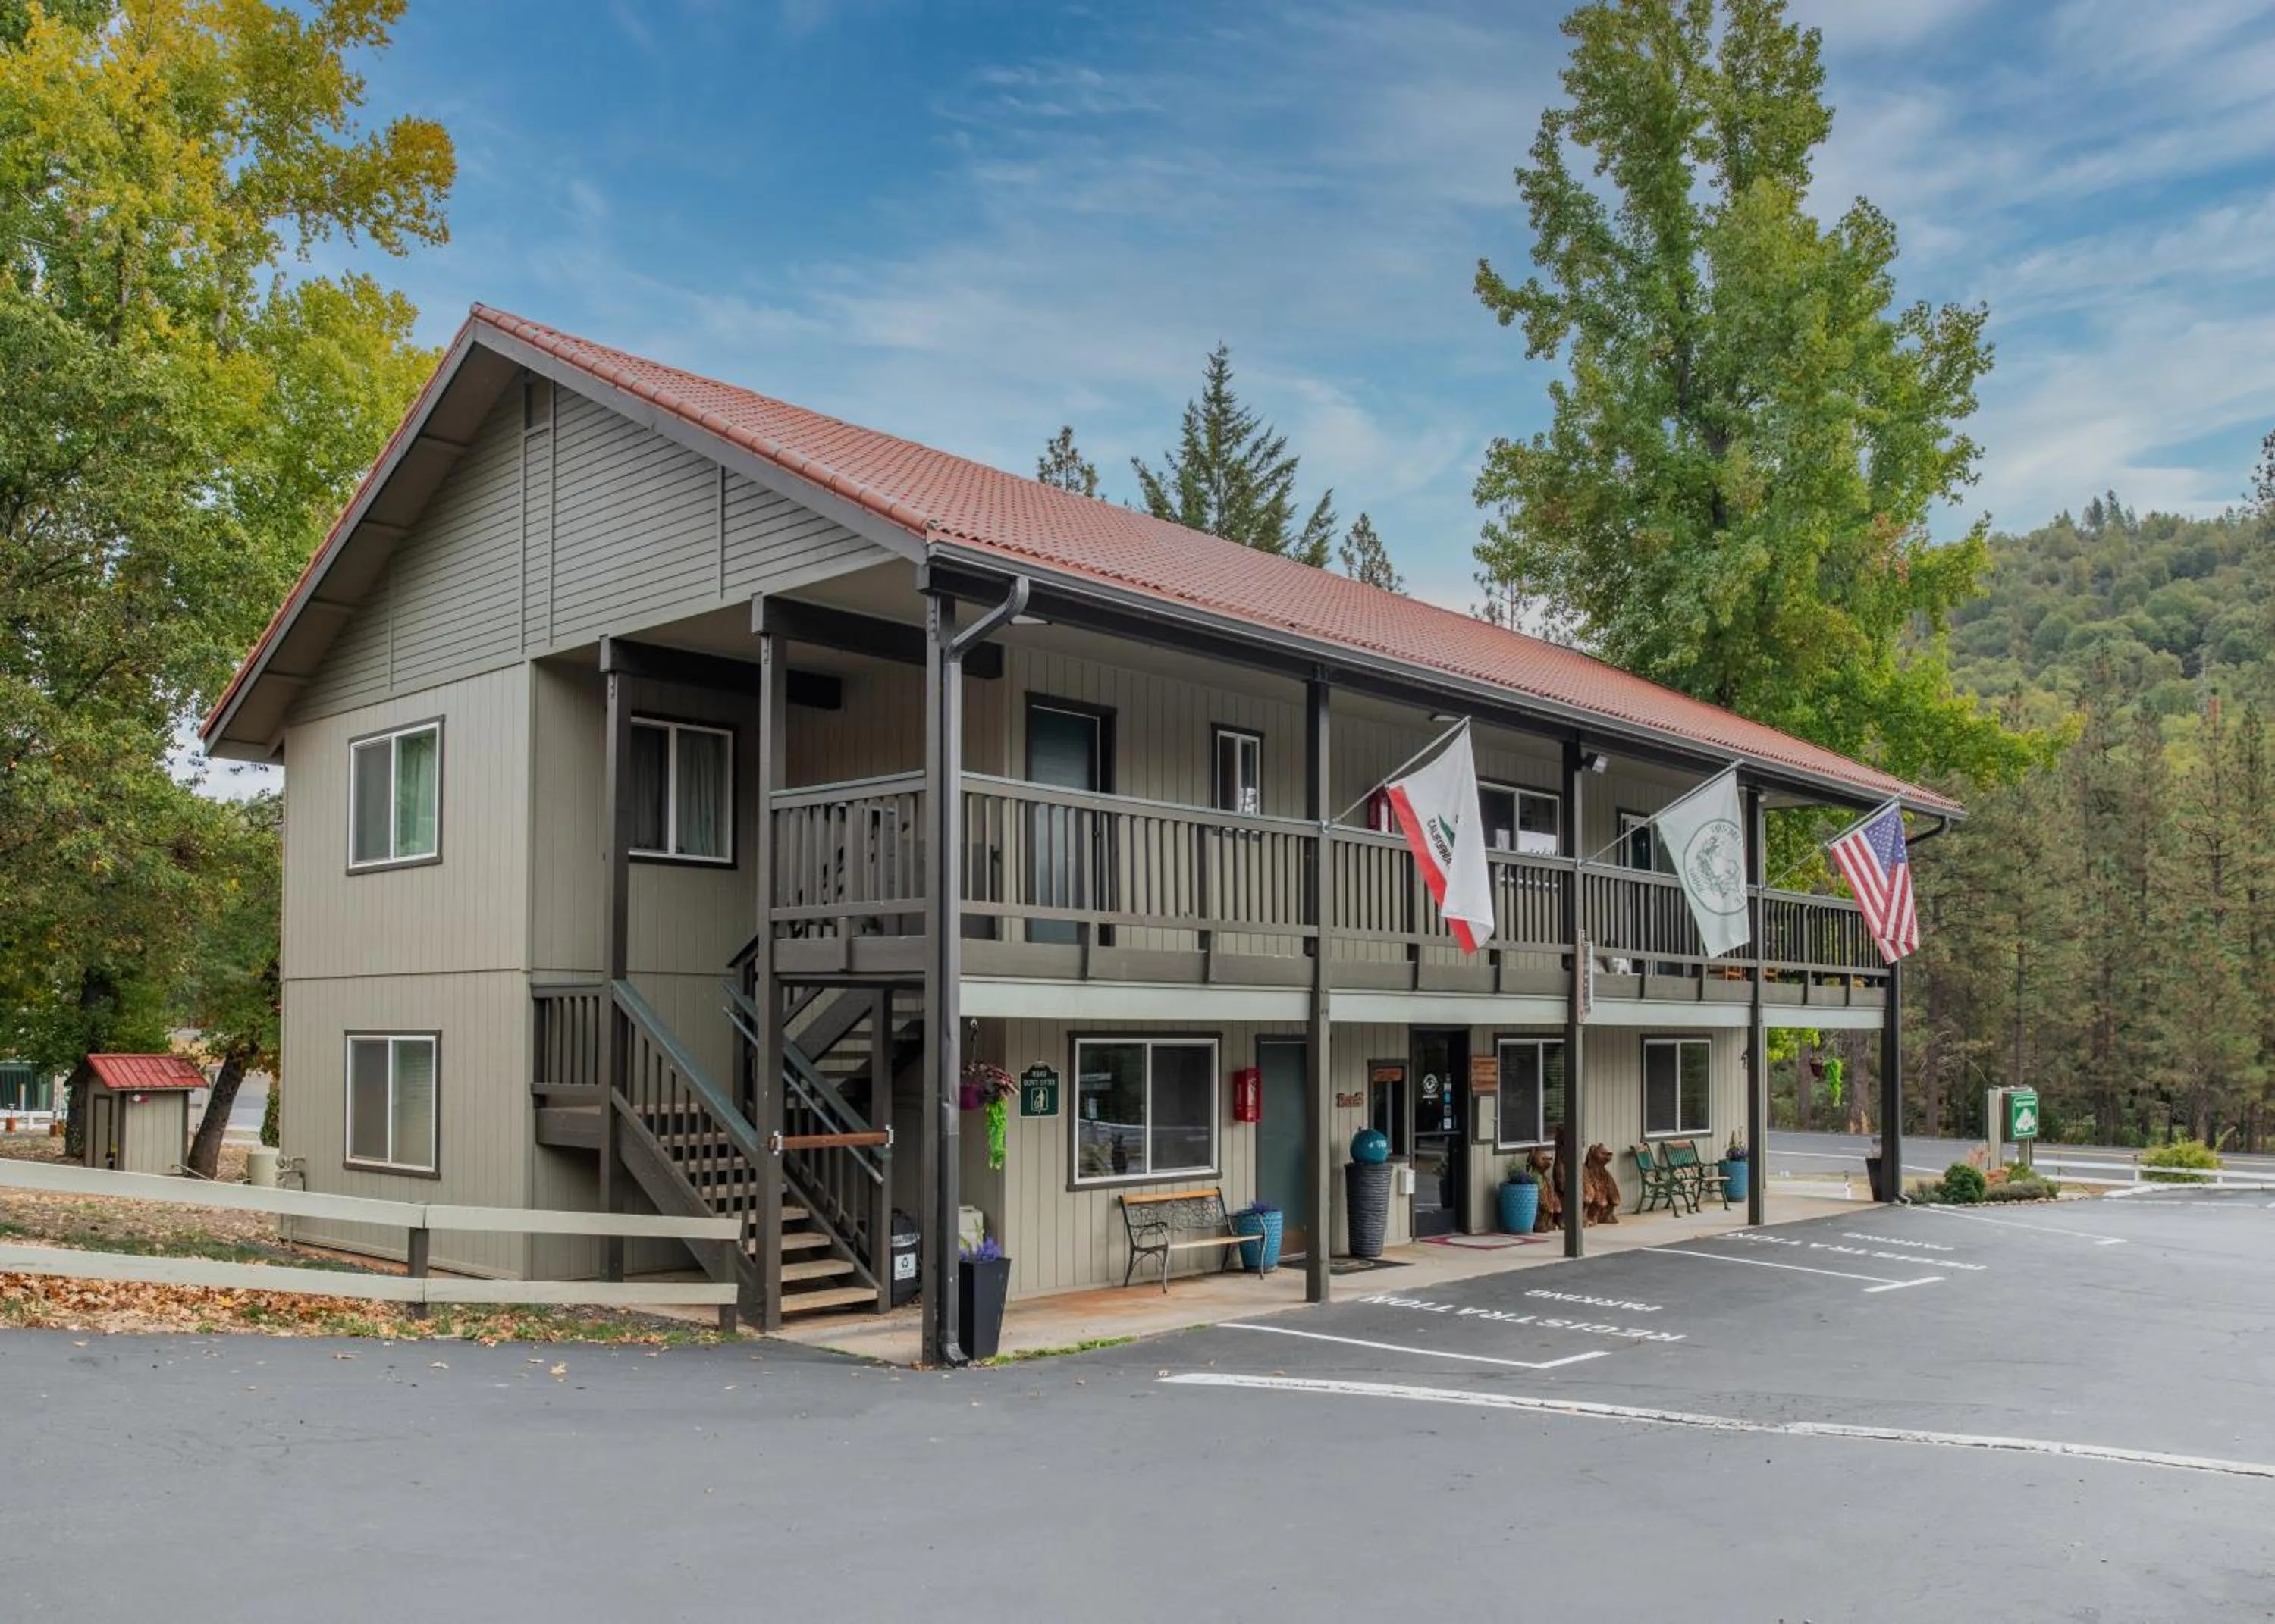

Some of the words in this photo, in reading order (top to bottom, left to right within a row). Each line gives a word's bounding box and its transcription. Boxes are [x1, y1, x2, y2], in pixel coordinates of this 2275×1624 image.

[1427, 817, 1452, 866] CALIFORNIA
[1358, 1294, 1687, 1343] REGISTRATION
[1524, 1290, 1662, 1312] PARKING
